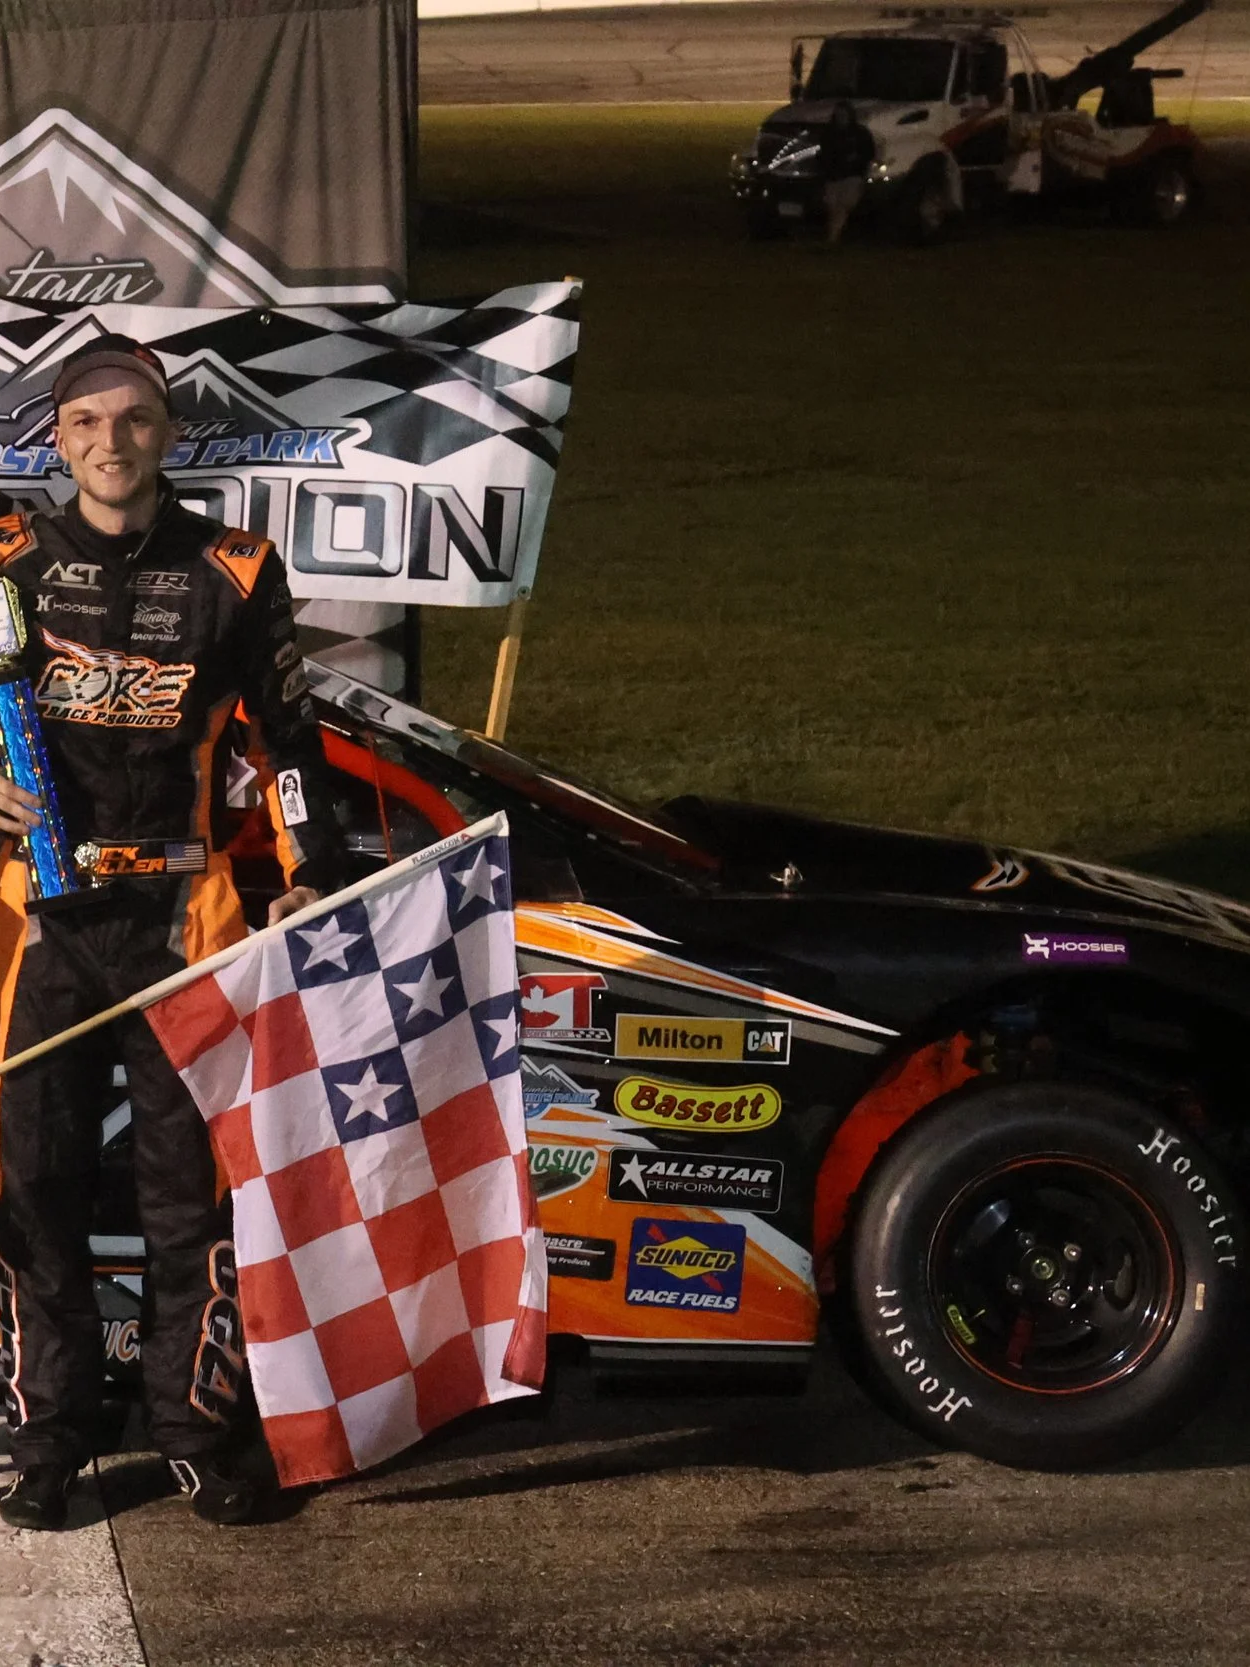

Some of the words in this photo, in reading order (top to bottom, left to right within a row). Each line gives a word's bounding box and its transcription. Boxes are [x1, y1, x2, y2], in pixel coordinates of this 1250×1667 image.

[196, 428, 346, 466] PARK
[53, 601, 108, 615] HOOSIER
[133, 611, 181, 624] SUNOCO
[47, 705, 90, 721] RACE
[94, 709, 180, 727] PRODUCTS
[1053, 941, 1126, 953] HOOSIER
[637, 1026, 723, 1050] Milton
[747, 1030, 784, 1053] CAT
[630, 1085, 767, 1124] Bassett
[646, 1161, 773, 1183] ALLSTAR
[647, 1179, 772, 1199] PERFORMANCE
[1137, 1127, 1236, 1268] Hoosier
[639, 1251, 734, 1269] SUNOCO
[627, 1288, 678, 1305] RACE
[680, 1289, 738, 1310] FUELS
[875, 1284, 974, 1422] Hoosier
